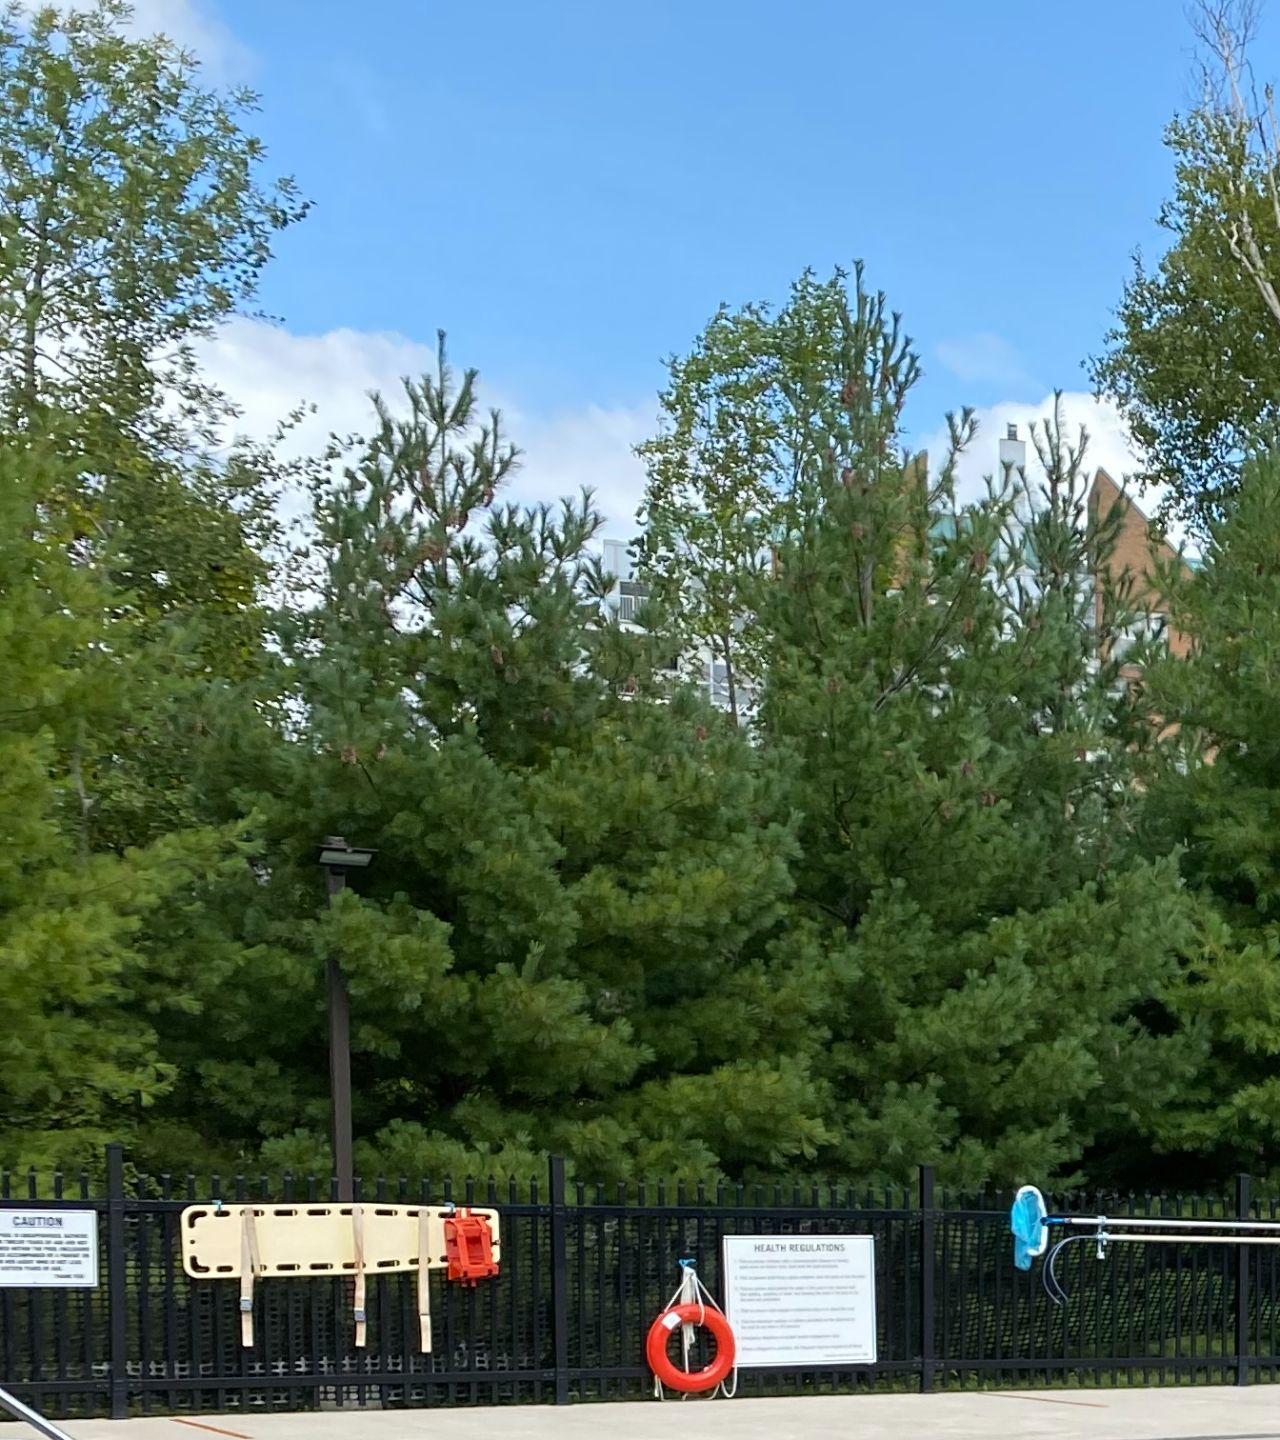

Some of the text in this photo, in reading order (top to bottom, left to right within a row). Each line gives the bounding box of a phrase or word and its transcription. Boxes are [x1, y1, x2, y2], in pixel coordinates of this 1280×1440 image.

[12, 1216, 62, 1226] CAUTION
[754, 1243, 846, 1253] HEALTH REGULATIONS
